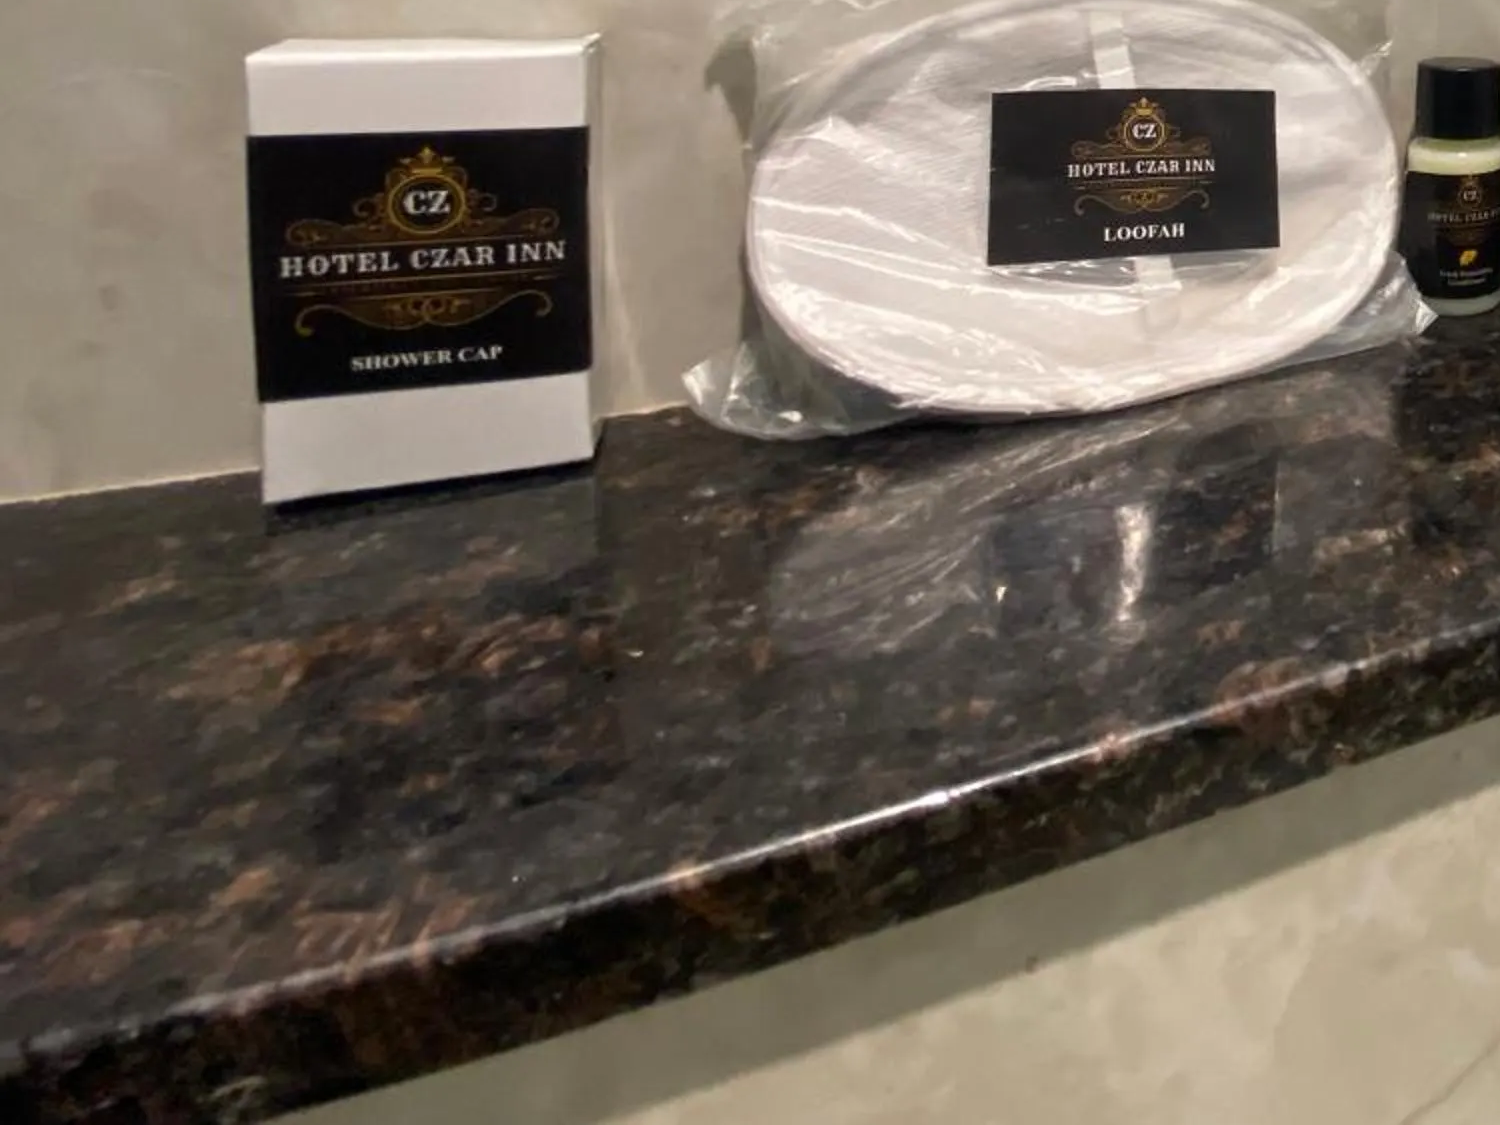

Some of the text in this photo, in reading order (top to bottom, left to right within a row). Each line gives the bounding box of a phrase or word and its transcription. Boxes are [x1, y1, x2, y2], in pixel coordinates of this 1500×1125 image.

[1132, 124, 1157, 140] CZ
[1068, 158, 1216, 178] HOTEL CZAR INN
[402, 190, 451, 216] CZ
[1103, 223, 1186, 243] LOOFAH
[279, 240, 567, 279] HOTEL CZAR INN
[351, 346, 504, 372] SHOWER CAP
